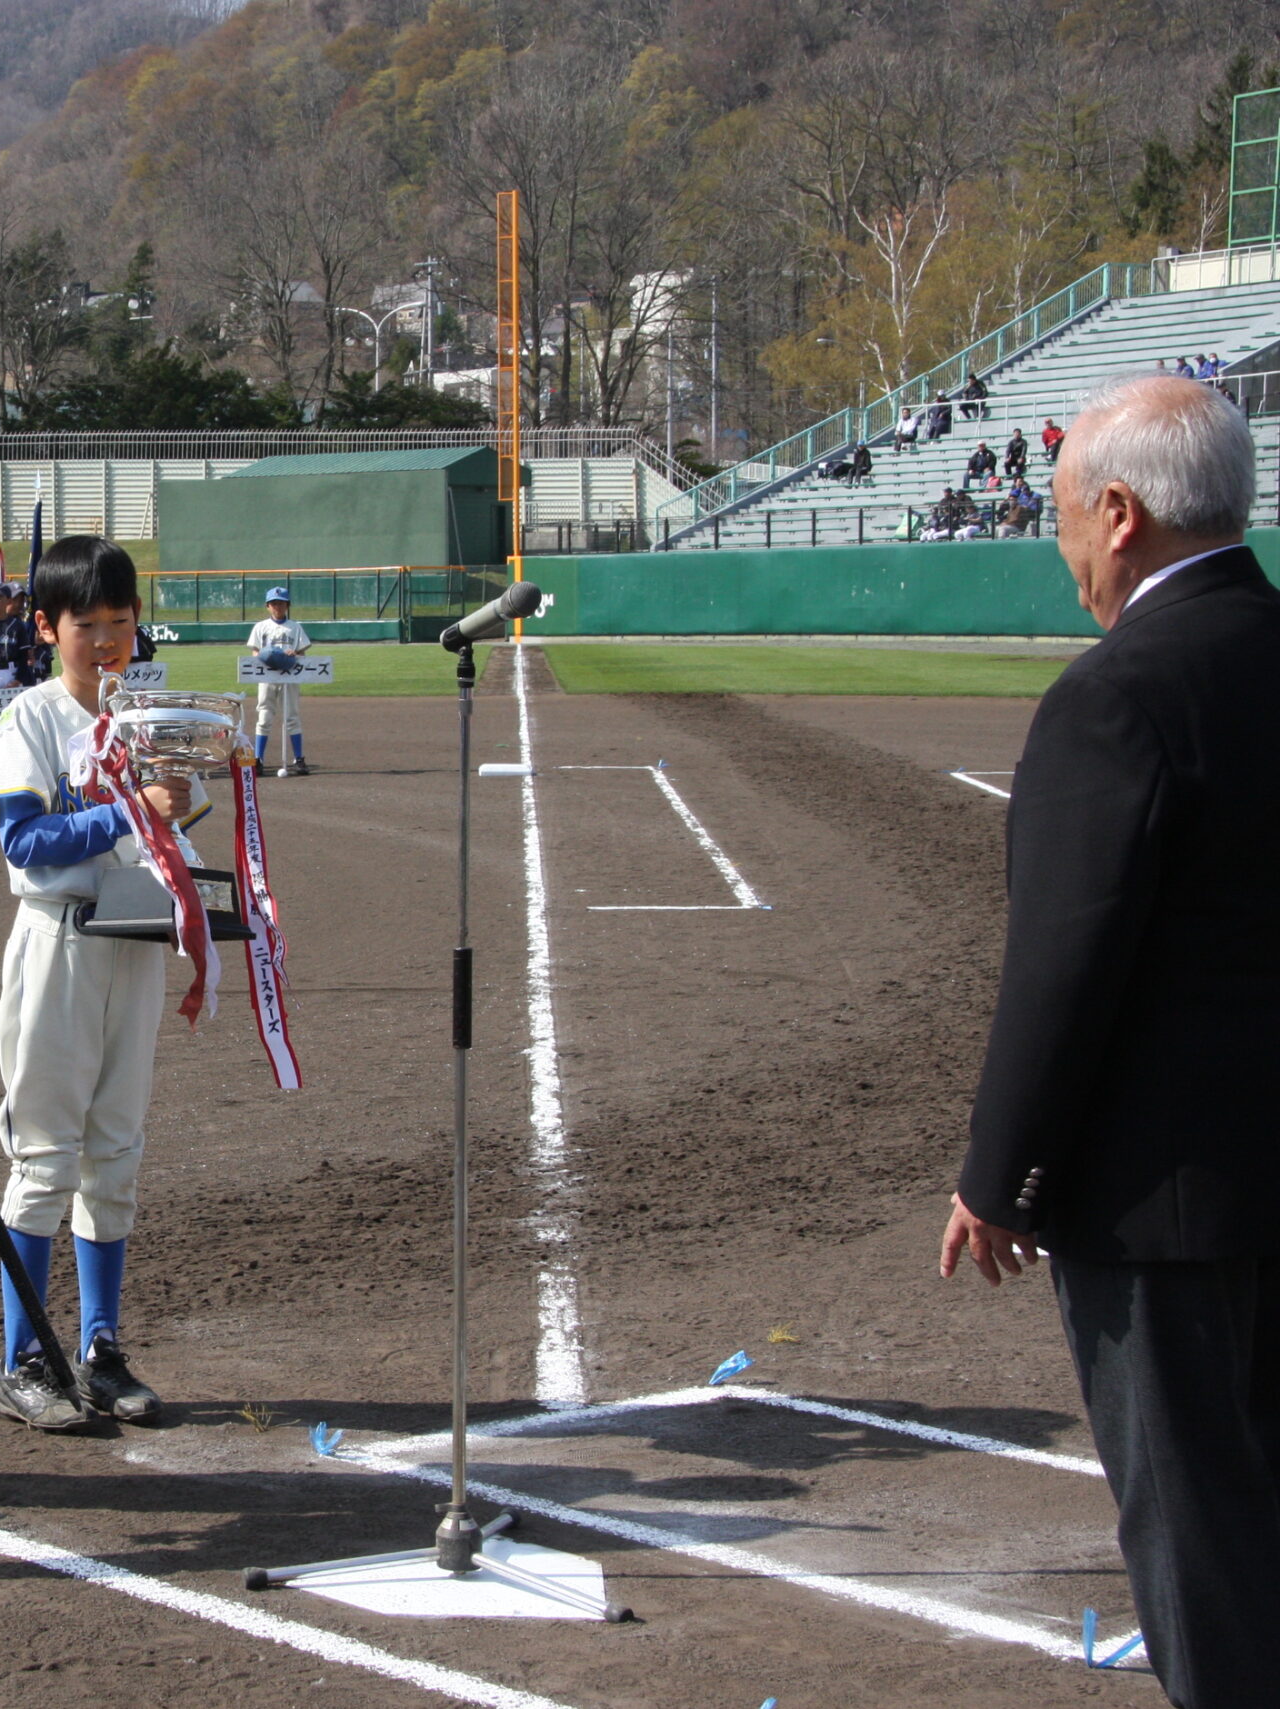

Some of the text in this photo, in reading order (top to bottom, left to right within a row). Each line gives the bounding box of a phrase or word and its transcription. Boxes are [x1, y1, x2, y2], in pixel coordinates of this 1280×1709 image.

[254, 947, 281, 1034] ニュースターズ
